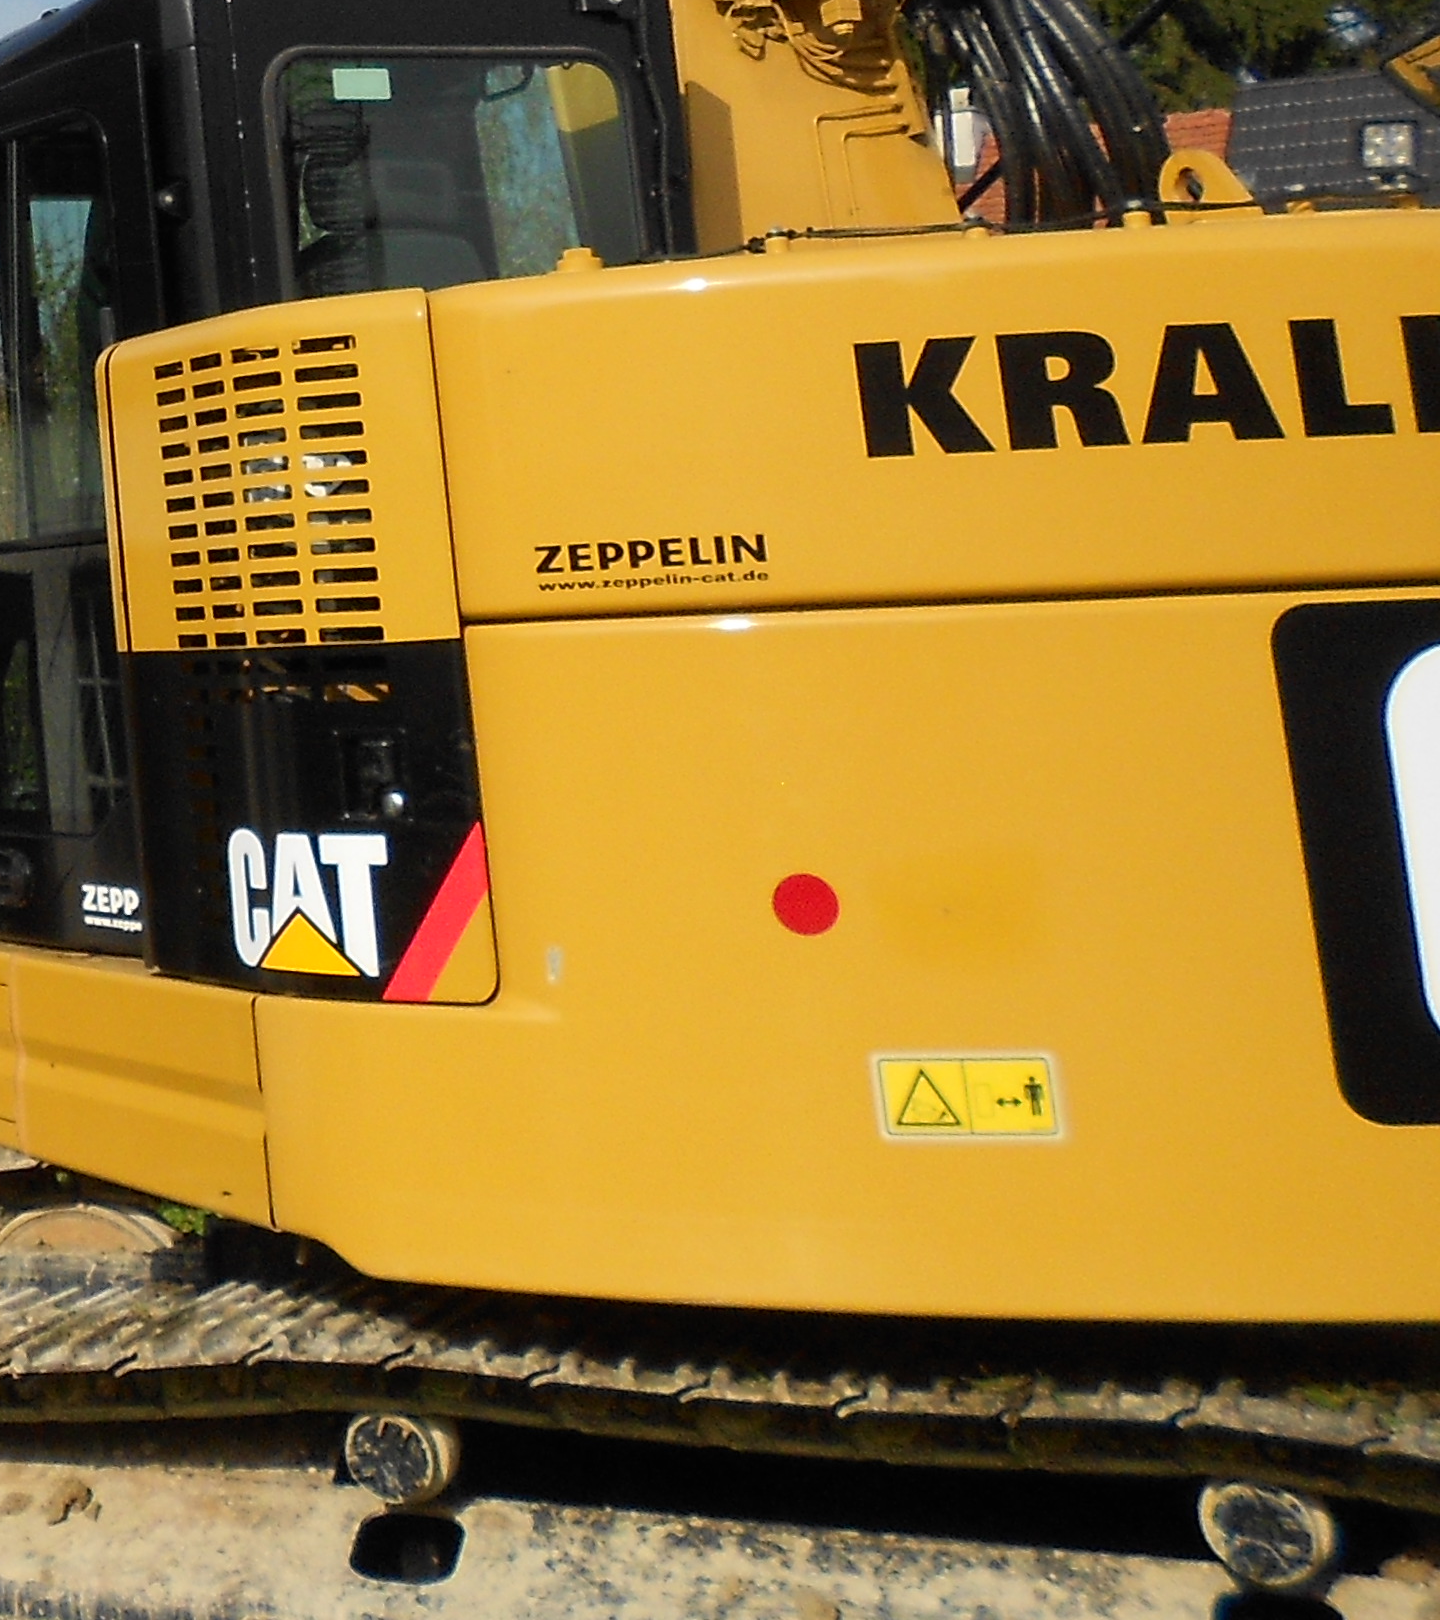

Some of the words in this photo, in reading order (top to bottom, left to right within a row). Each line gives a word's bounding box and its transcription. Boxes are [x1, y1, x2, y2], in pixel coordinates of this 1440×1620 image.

[534, 534, 768, 574] ZEPPELIN
[538, 570, 769, 592] www.zeppelin-cat.de
[228, 828, 388, 977] CAT
